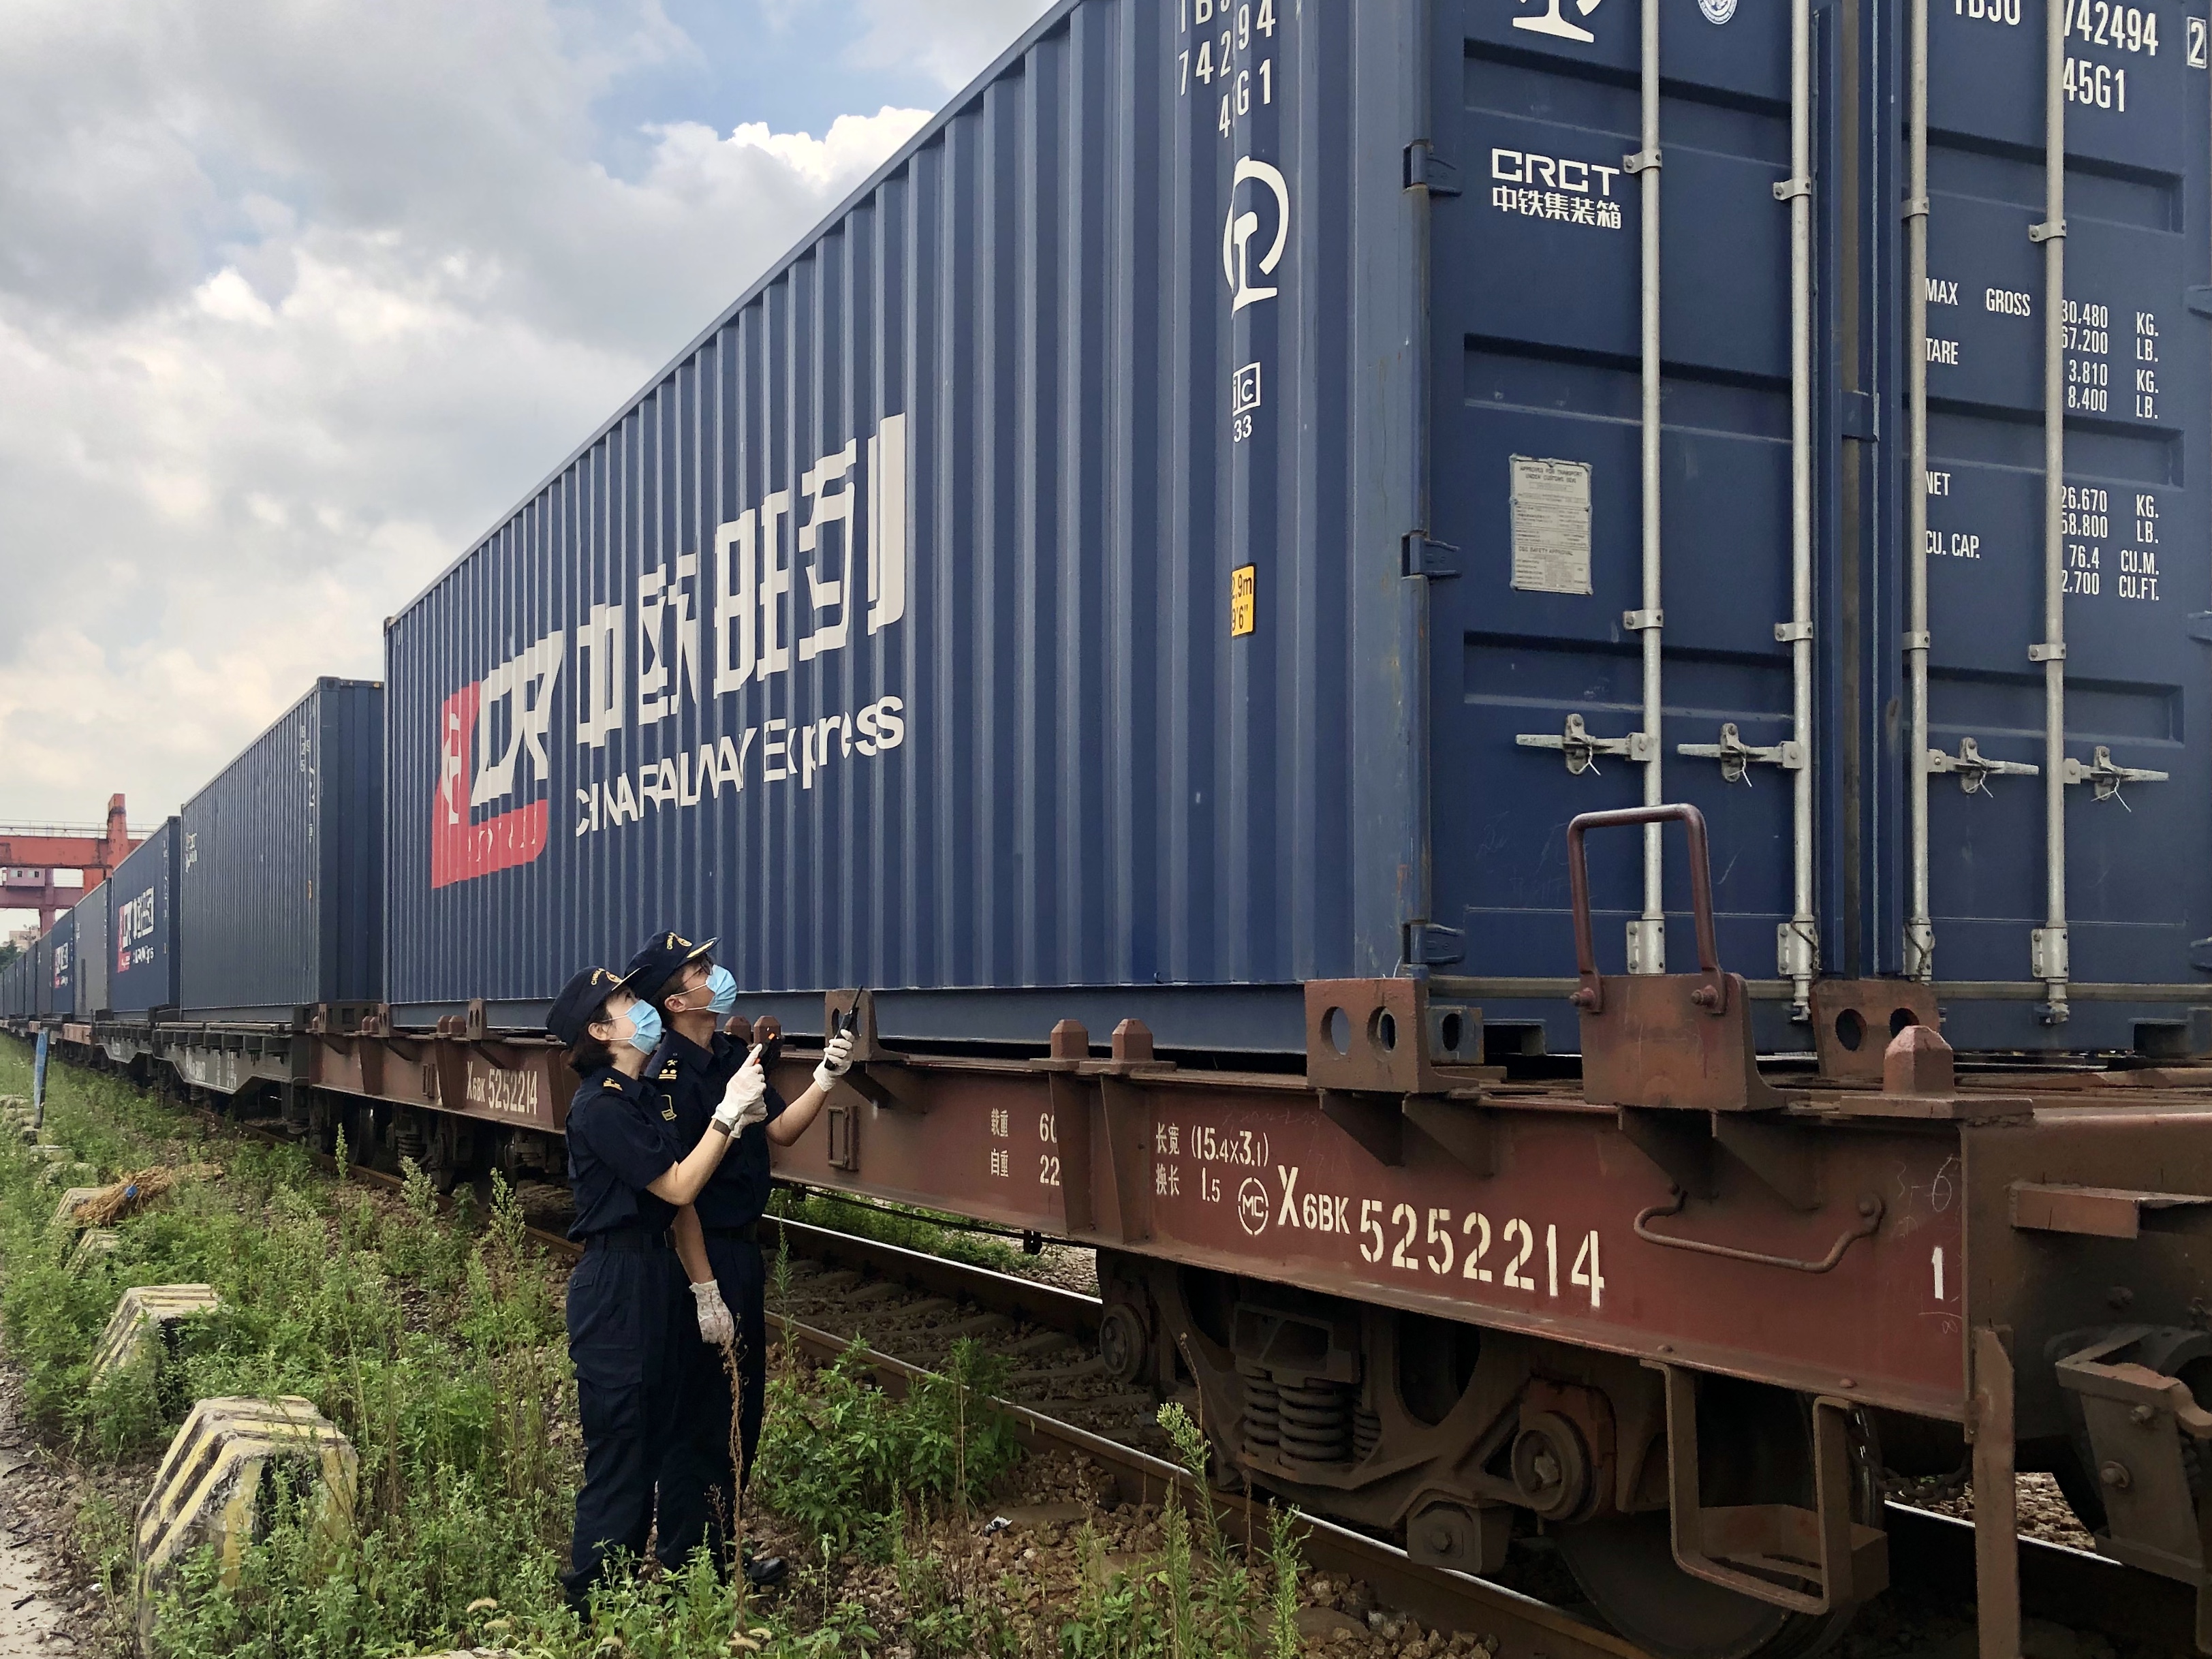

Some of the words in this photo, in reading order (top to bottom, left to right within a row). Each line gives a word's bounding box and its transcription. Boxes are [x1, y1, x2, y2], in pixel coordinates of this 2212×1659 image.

[2063, 57, 2125, 112] 45G1
[1492, 149, 1620, 196] CRCT
[1493, 185, 1621, 230] 中铁集装箱
[1925, 278, 1959, 306] MAX
[1986, 288, 2031, 317] GROSS
[2136, 311, 2159, 337] KG.
[1926, 338, 1959, 365] TARE
[2136, 369, 2159, 394] KG.
[2136, 338, 2159, 362] LB.
[2136, 394, 2159, 420] LB.
[1234, 415, 1252, 442] 33
[2136, 494, 2159, 518] KG.
[2136, 520, 2159, 544] LB.
[1926, 531, 1946, 555] CU.
[1952, 533, 1980, 559] CAP.
[2069, 544, 2100, 570] 76.4
[2121, 549, 2160, 575] CU.M.
[2119, 575, 2160, 601] CU.FT.
[467, 1061, 485, 1102] X6BK
[488, 1068, 538, 1115] 5252214
[1156, 1122, 1179, 1155] 长宽
[991, 1148, 1008, 1177] 自重
[1040, 1155, 1059, 1185] 22
[1156, 1163, 1179, 1196] 换长
[1202, 1167, 1220, 1203] 1.5
[1242, 1194, 1264, 1218] MC
[1277, 1165, 1350, 1234] X6BK
[1360, 1199, 1604, 1307] 5252214
[1932, 1246, 1944, 1299] 1
